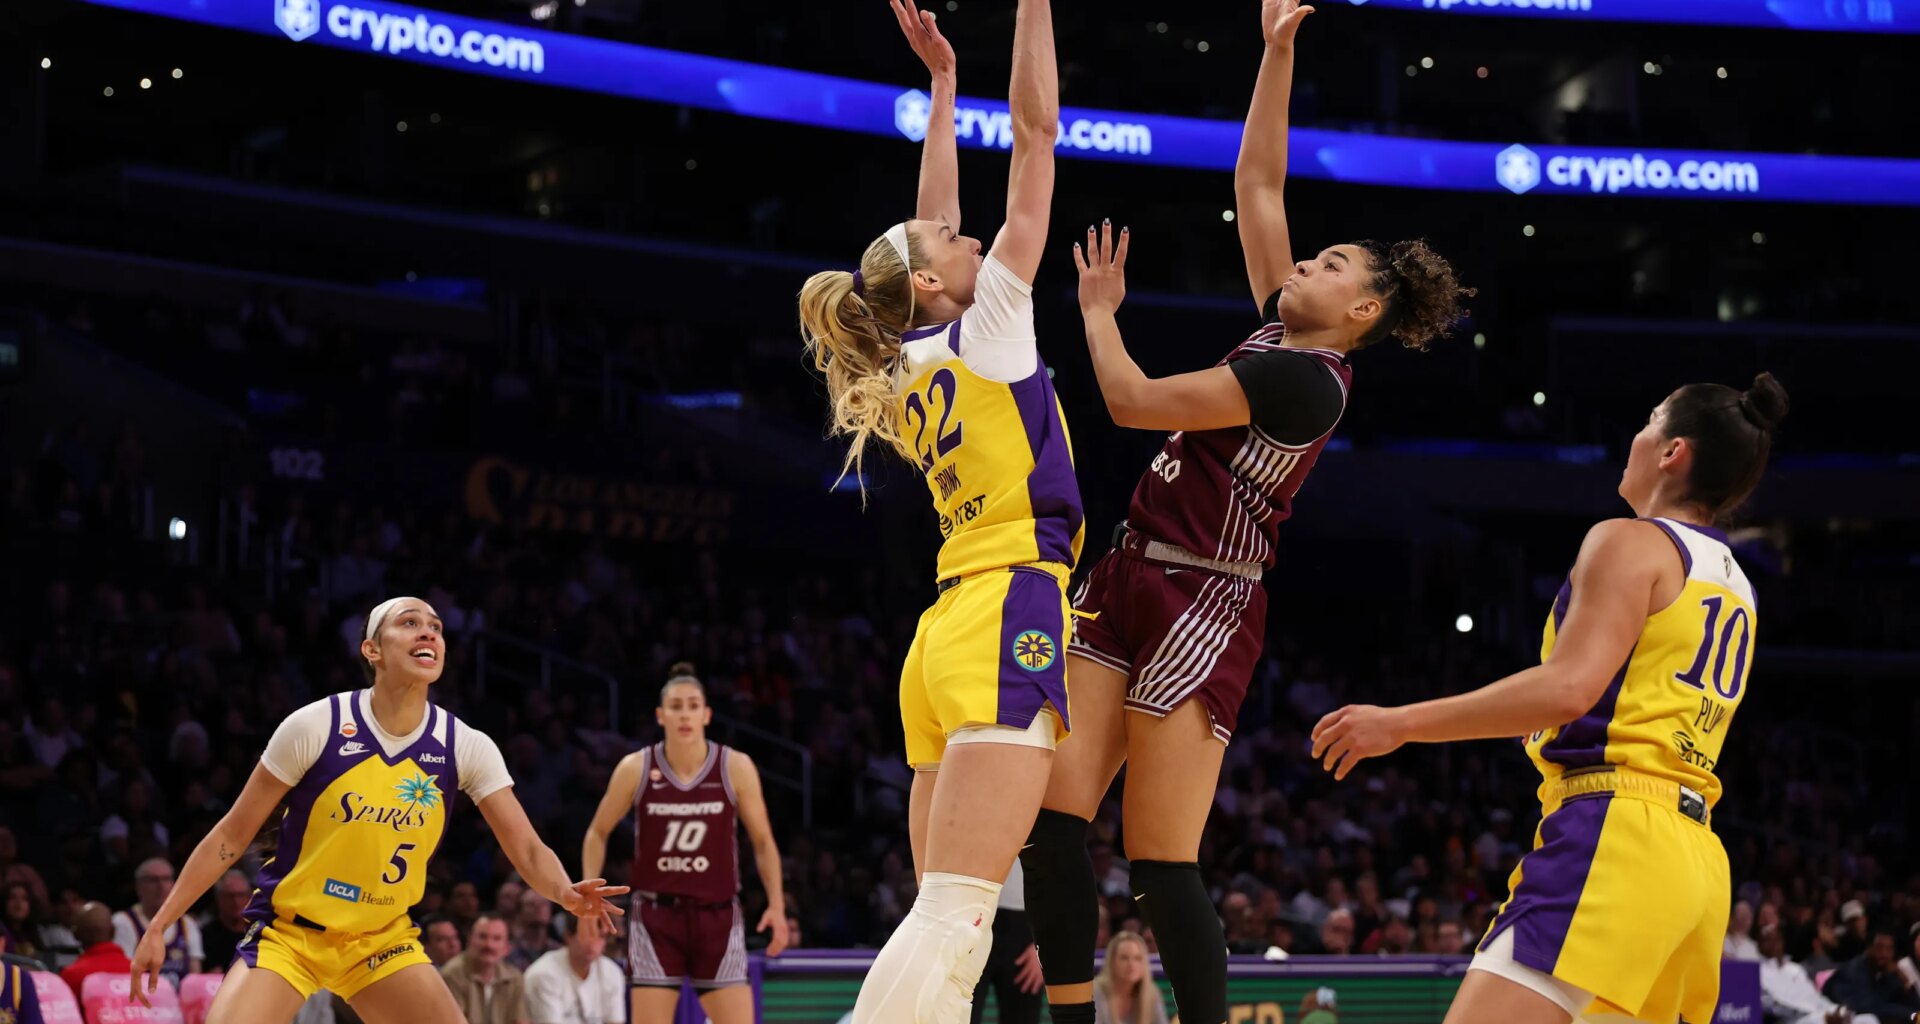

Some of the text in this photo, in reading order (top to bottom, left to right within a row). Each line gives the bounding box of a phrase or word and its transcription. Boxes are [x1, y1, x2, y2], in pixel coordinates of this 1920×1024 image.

[327, 4, 545, 73] crypto.com
[953, 107, 1152, 155] cryp.com
[1546, 153, 1759, 193] crypto.com
[905, 368, 963, 476] 22
[268, 446, 327, 480] 102
[934, 462, 962, 502] BRINK
[1675, 596, 1750, 699] 10
[1694, 696, 1727, 734] PLU
[343, 740, 366, 751] NIKE
[419, 752, 446, 765] Albert
[330, 791, 430, 833] SPARKS
[646, 801, 725, 816] TORONTO
[660, 820, 708, 852] 10
[381, 843, 417, 885] 5
[328, 882, 395, 906] UCLA Health
[376, 944, 415, 964] WNBA
